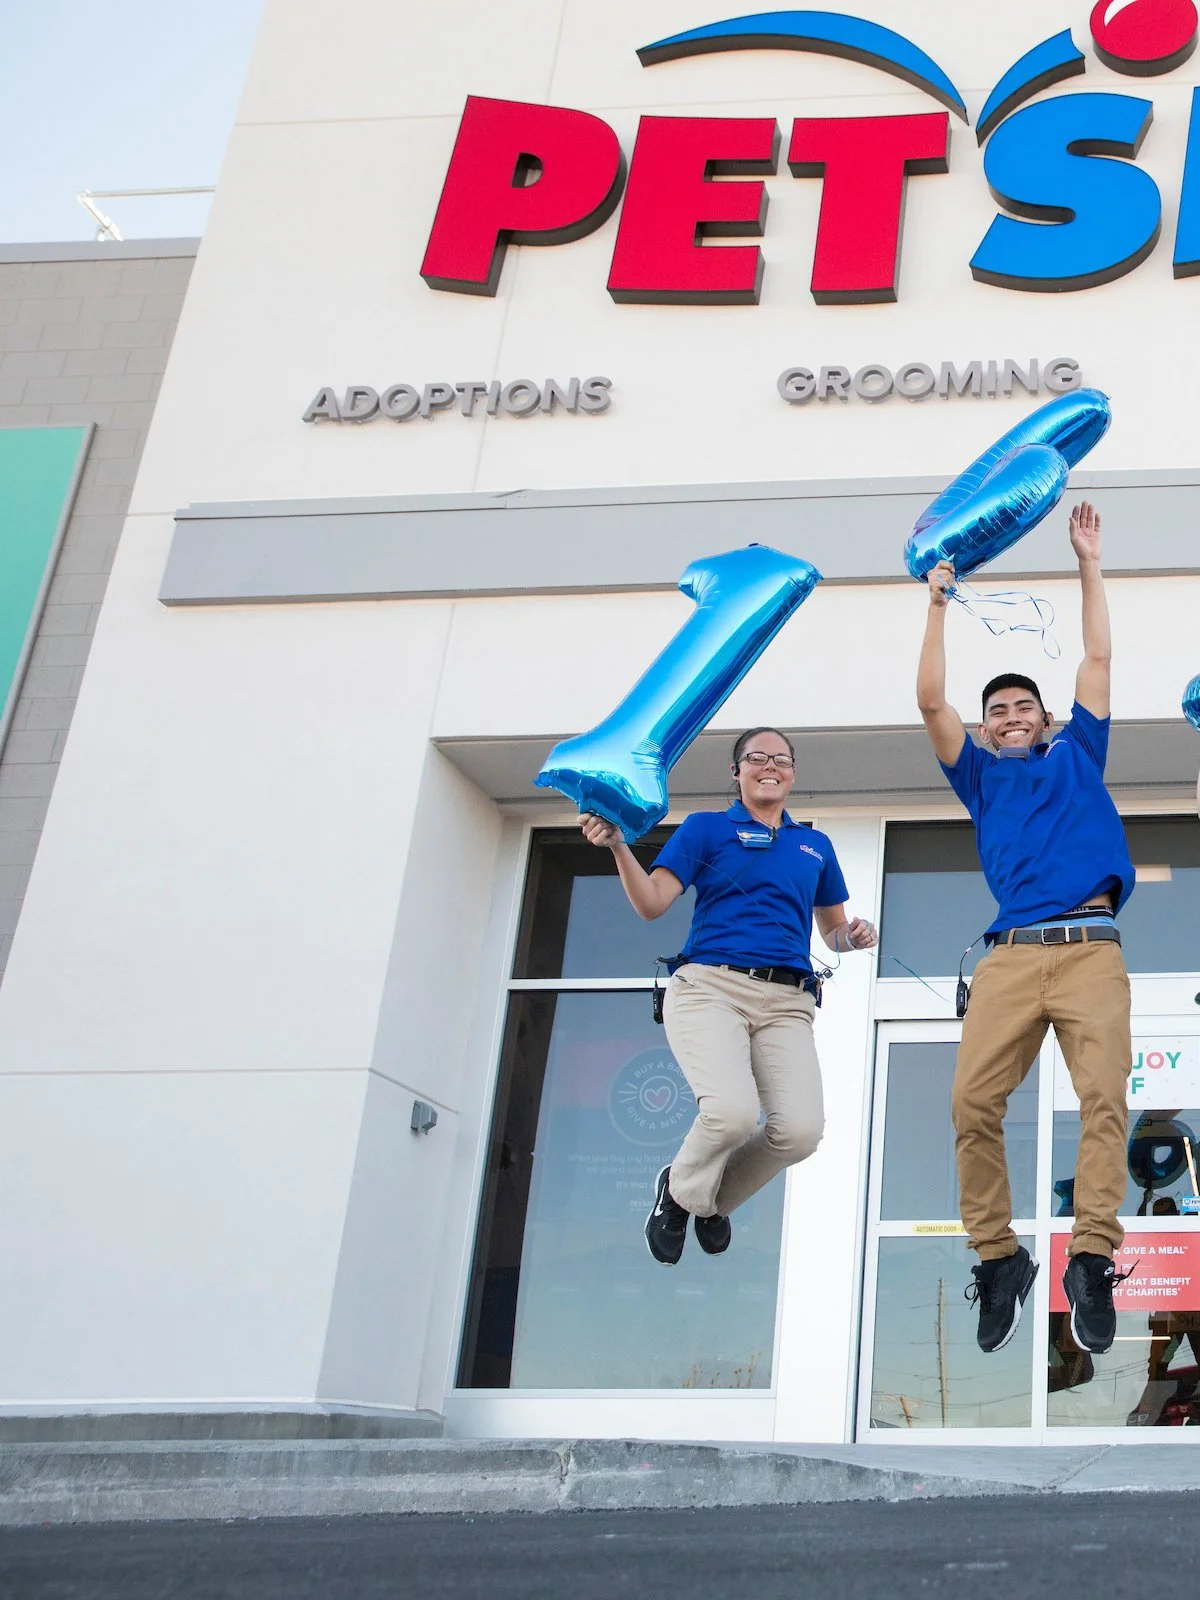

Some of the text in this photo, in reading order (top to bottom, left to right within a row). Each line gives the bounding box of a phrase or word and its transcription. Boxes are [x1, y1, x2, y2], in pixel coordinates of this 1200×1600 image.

[776, 357, 1083, 402] GROOMING
[301, 376, 613, 424] ADOPTIONS
[634, 1062, 654, 1079] BUY
[657, 1061, 666, 1069] A
[627, 1106, 688, 1130] GIVE A MEAL
[916, 1225, 943, 1233] AUTOMATIC
[944, 1225, 957, 1233] DOOR
[1123, 1246, 1146, 1255] GIVE
[1148, 1246, 1156, 1254] A
[1123, 1277, 1148, 1286] THAT
[1150, 1277, 1191, 1286] BENEFIT
